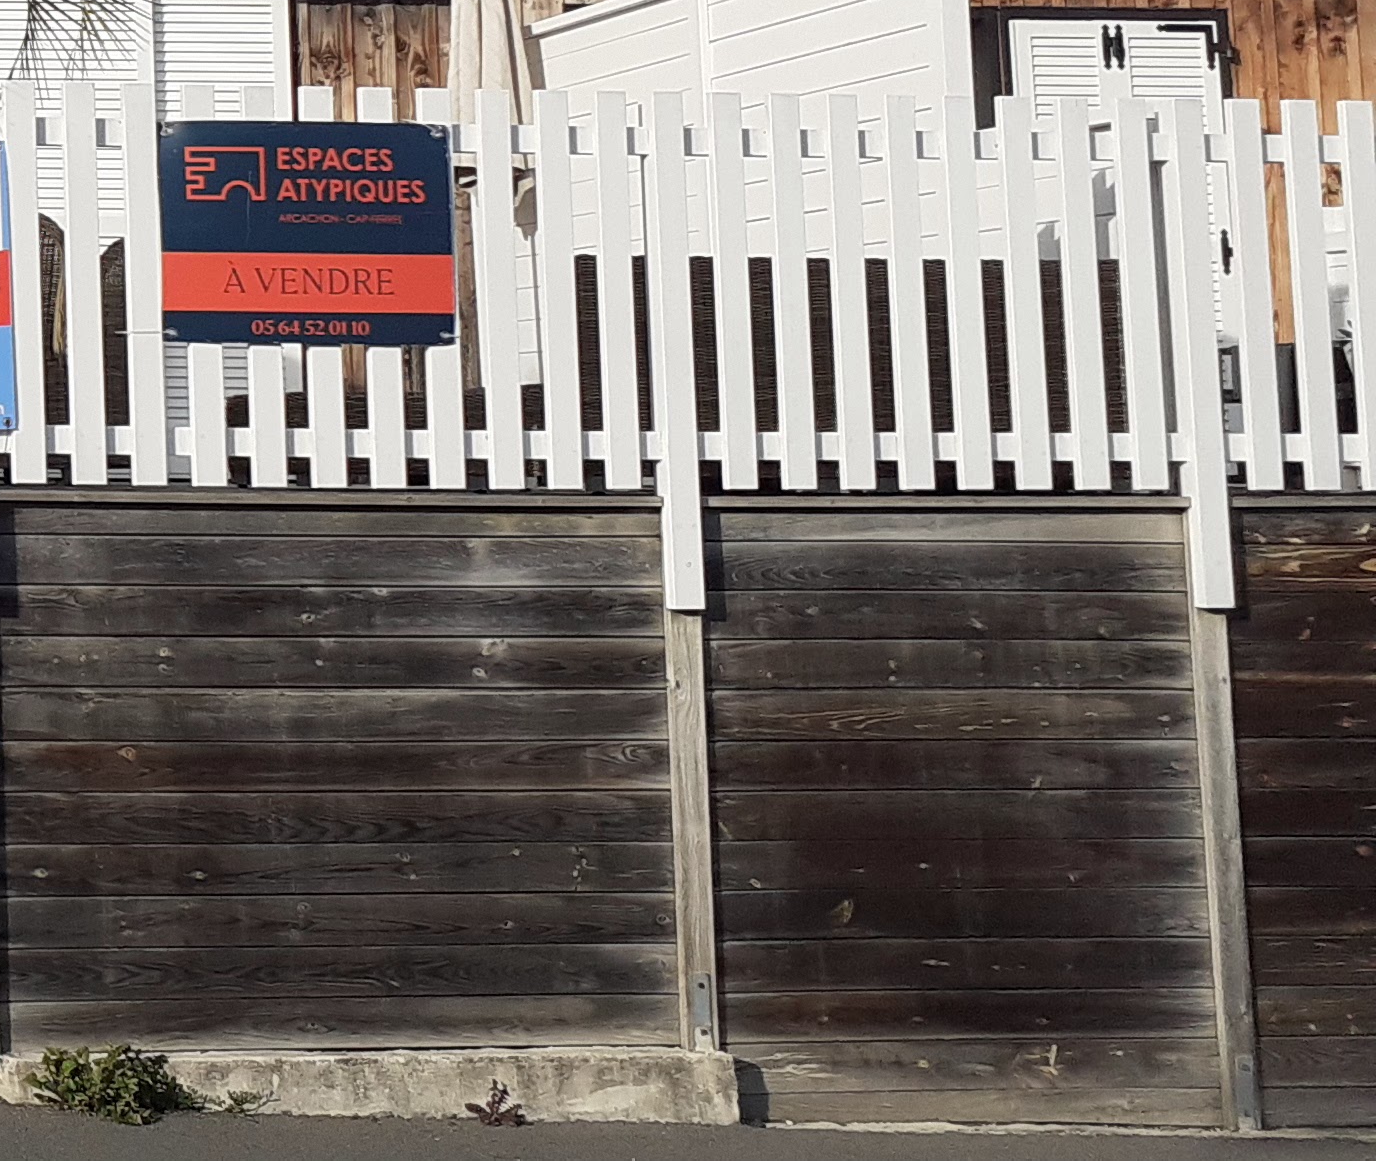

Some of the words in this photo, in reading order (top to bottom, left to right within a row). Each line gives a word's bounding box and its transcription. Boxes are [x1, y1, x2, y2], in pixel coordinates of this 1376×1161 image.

[276, 146, 394, 172] ESPACES
[277, 178, 427, 204] ATYPIQUES
[223, 260, 246, 294] À
[255, 267, 396, 297] VENDRE
[251, 320, 275, 336] 05
[277, 320, 300, 336] 64
[303, 320, 326, 336] 52
[328, 320, 347, 336] 01
[351, 320, 371, 336] 10
